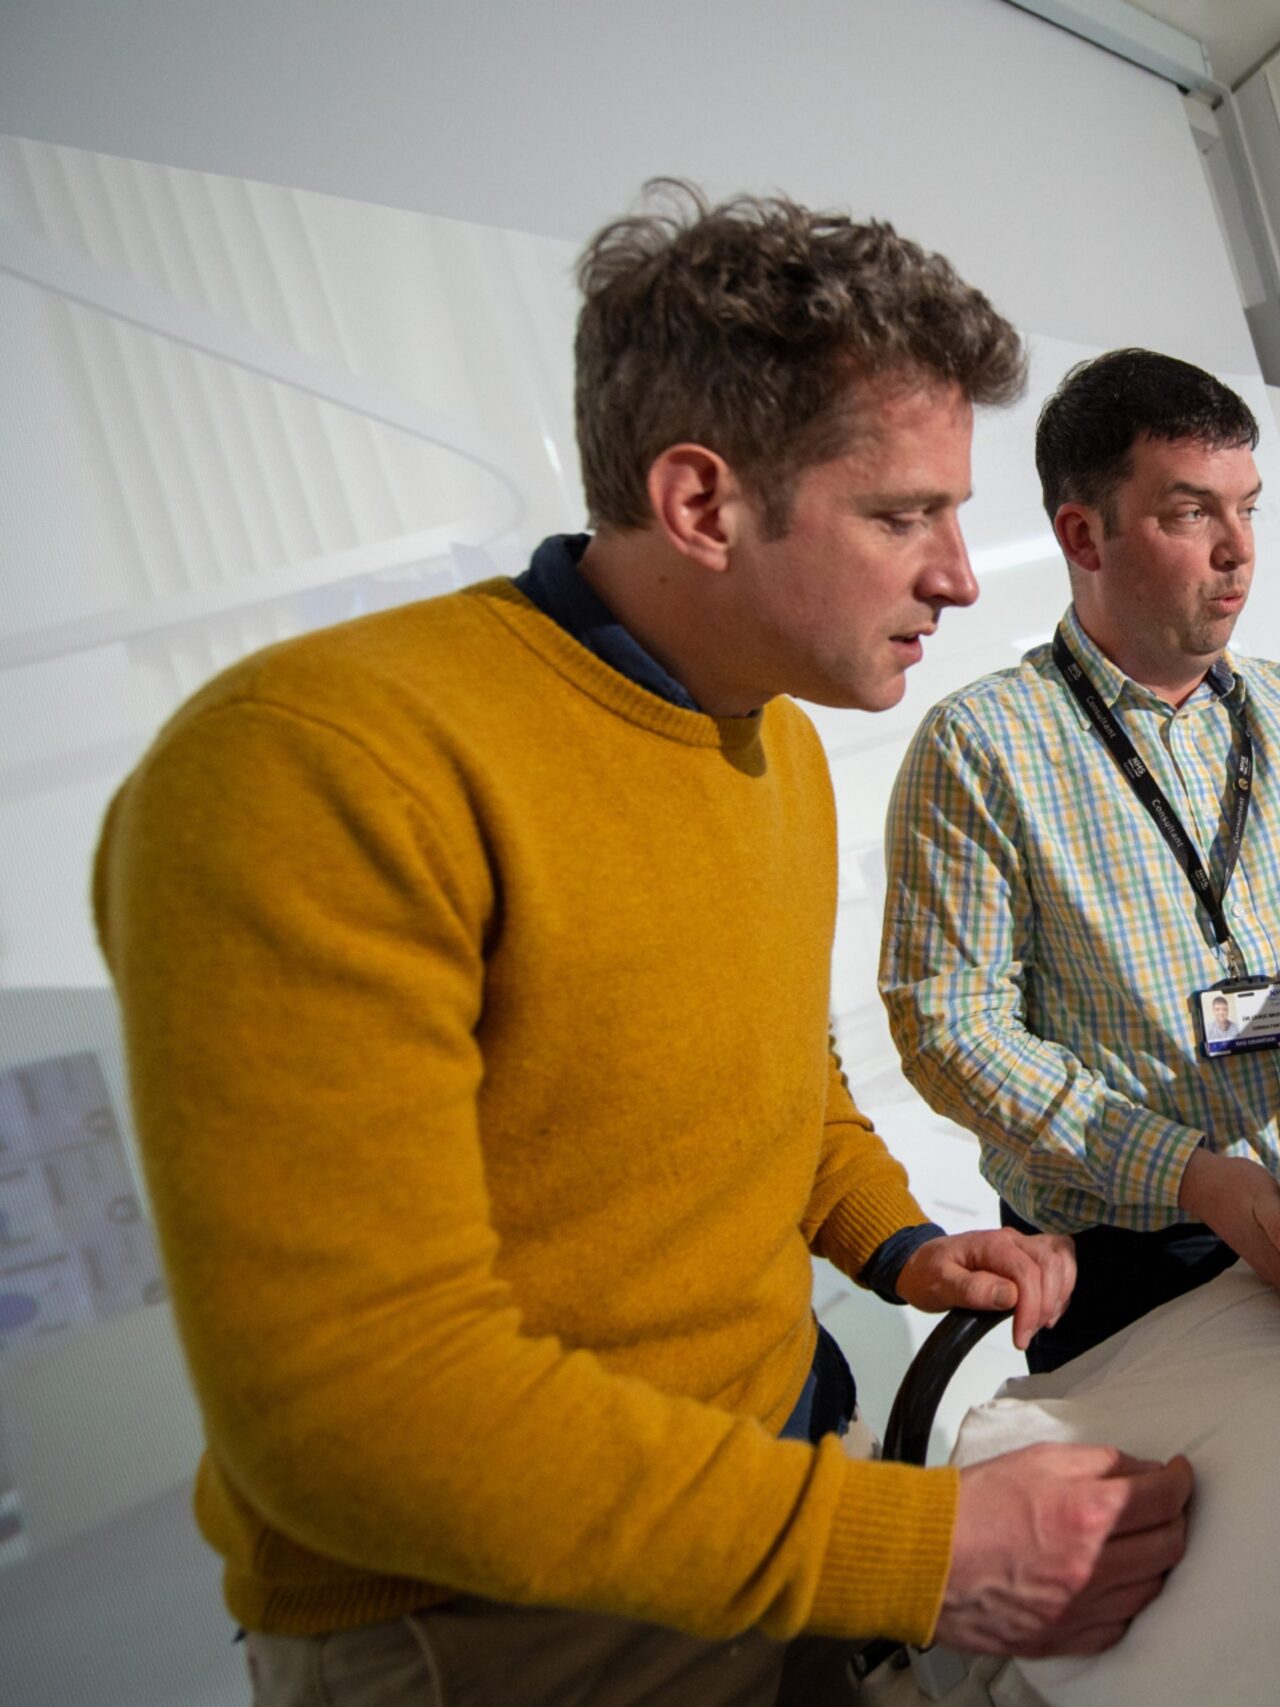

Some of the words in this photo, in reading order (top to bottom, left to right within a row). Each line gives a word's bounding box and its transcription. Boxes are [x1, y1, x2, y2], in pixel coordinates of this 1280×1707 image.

[1085, 695, 1117, 739] Consultant
[1152, 798, 1184, 849] Consultant
[1233, 797, 1246, 844] Consultant
